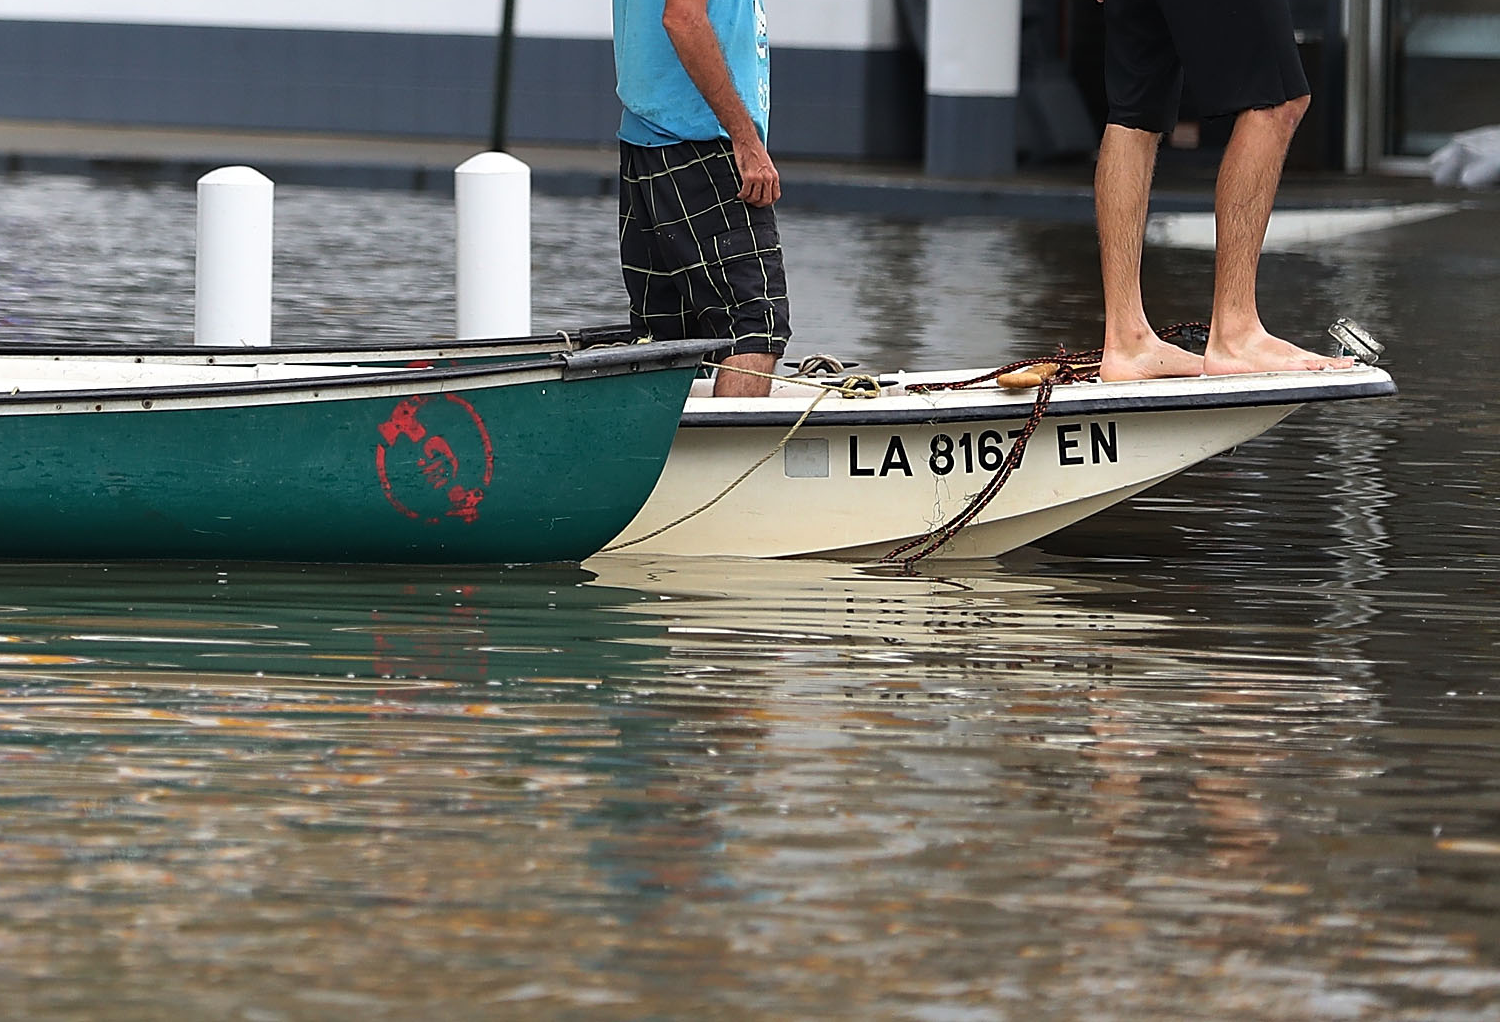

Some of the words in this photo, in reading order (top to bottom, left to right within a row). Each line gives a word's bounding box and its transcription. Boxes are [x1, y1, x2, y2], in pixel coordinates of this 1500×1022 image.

[850, 434, 914, 478] LA
[928, 427, 1029, 477] 8167
[1056, 421, 1119, 467] EN
